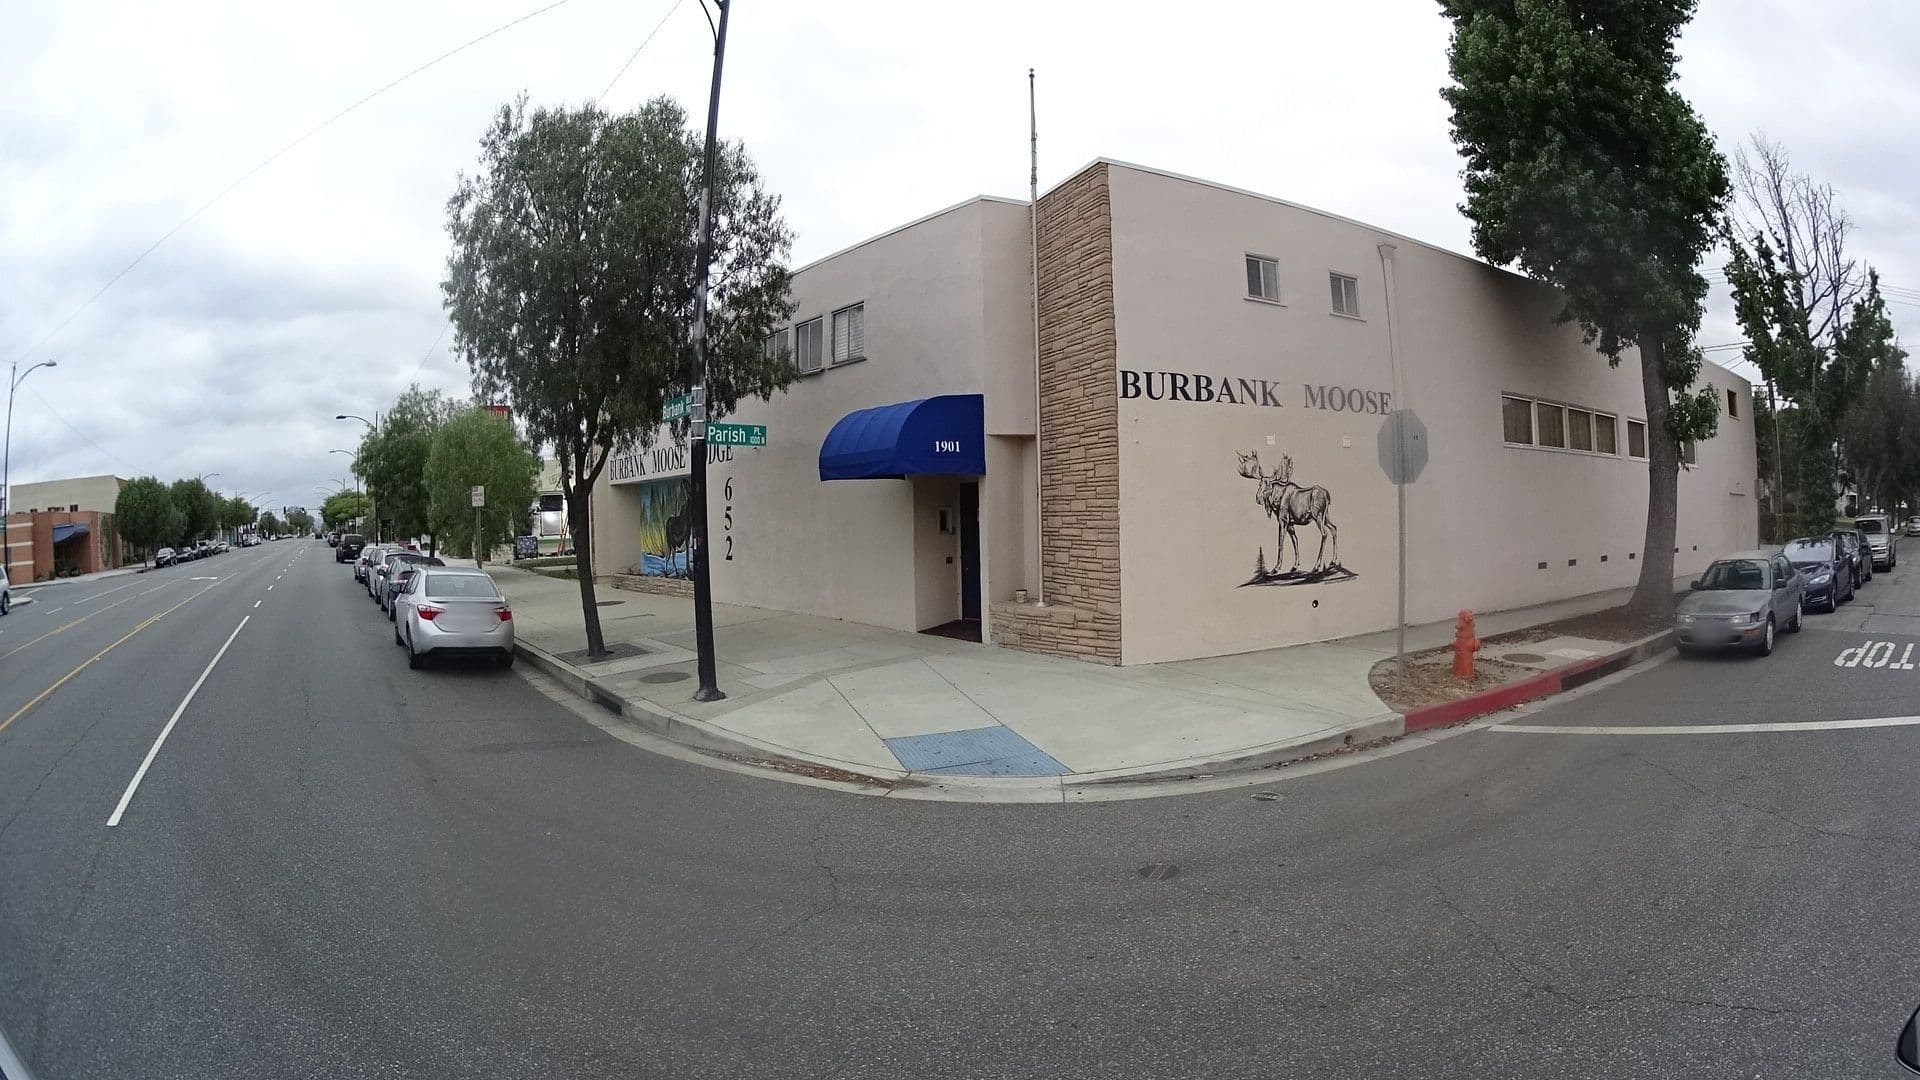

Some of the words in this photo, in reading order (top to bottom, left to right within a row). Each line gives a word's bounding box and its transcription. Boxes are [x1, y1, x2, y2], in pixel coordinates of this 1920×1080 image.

[1119, 370, 1283, 408] BURBANK
[1303, 383, 1392, 416] MOOSE
[662, 400, 685, 420] Burbank
[708, 426, 746, 443] Parish
[753, 426, 762, 436] PL
[935, 440, 960, 453] 1901
[610, 454, 646, 480] BURBANK
[652, 446, 686, 474] MOOSE
[708, 444, 734, 465] DGE
[1833, 640, 1920, 670] TOP
